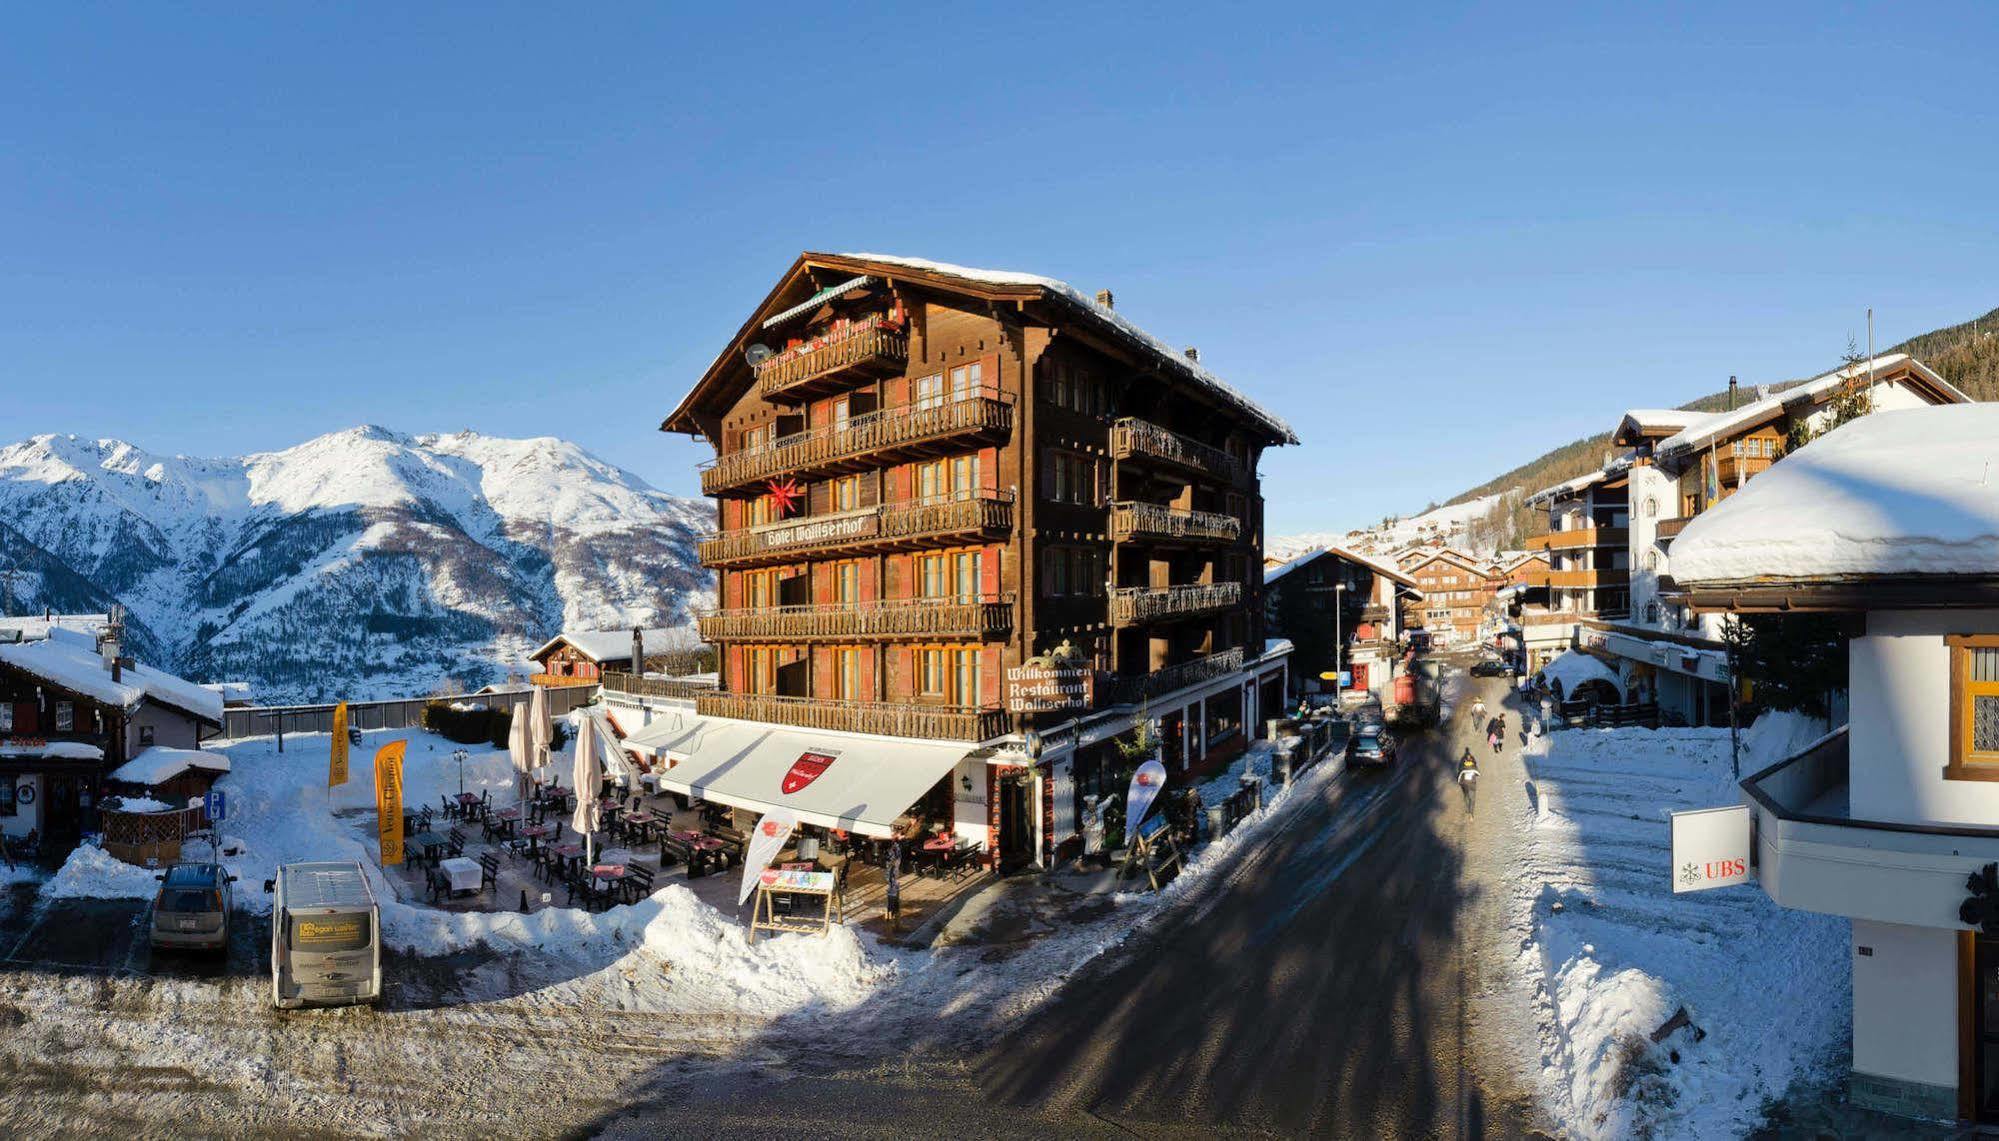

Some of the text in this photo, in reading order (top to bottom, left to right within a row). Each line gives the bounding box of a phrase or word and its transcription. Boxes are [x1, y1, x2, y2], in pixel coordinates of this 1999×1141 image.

[767, 516, 865, 546] Hotel Walliserhof
[1007, 667, 1092, 681] Willkommen
[1009, 680, 1089, 698] Restaurant
[1010, 694, 1091, 712] Walliserhof
[1704, 857, 1746, 880] UBS
